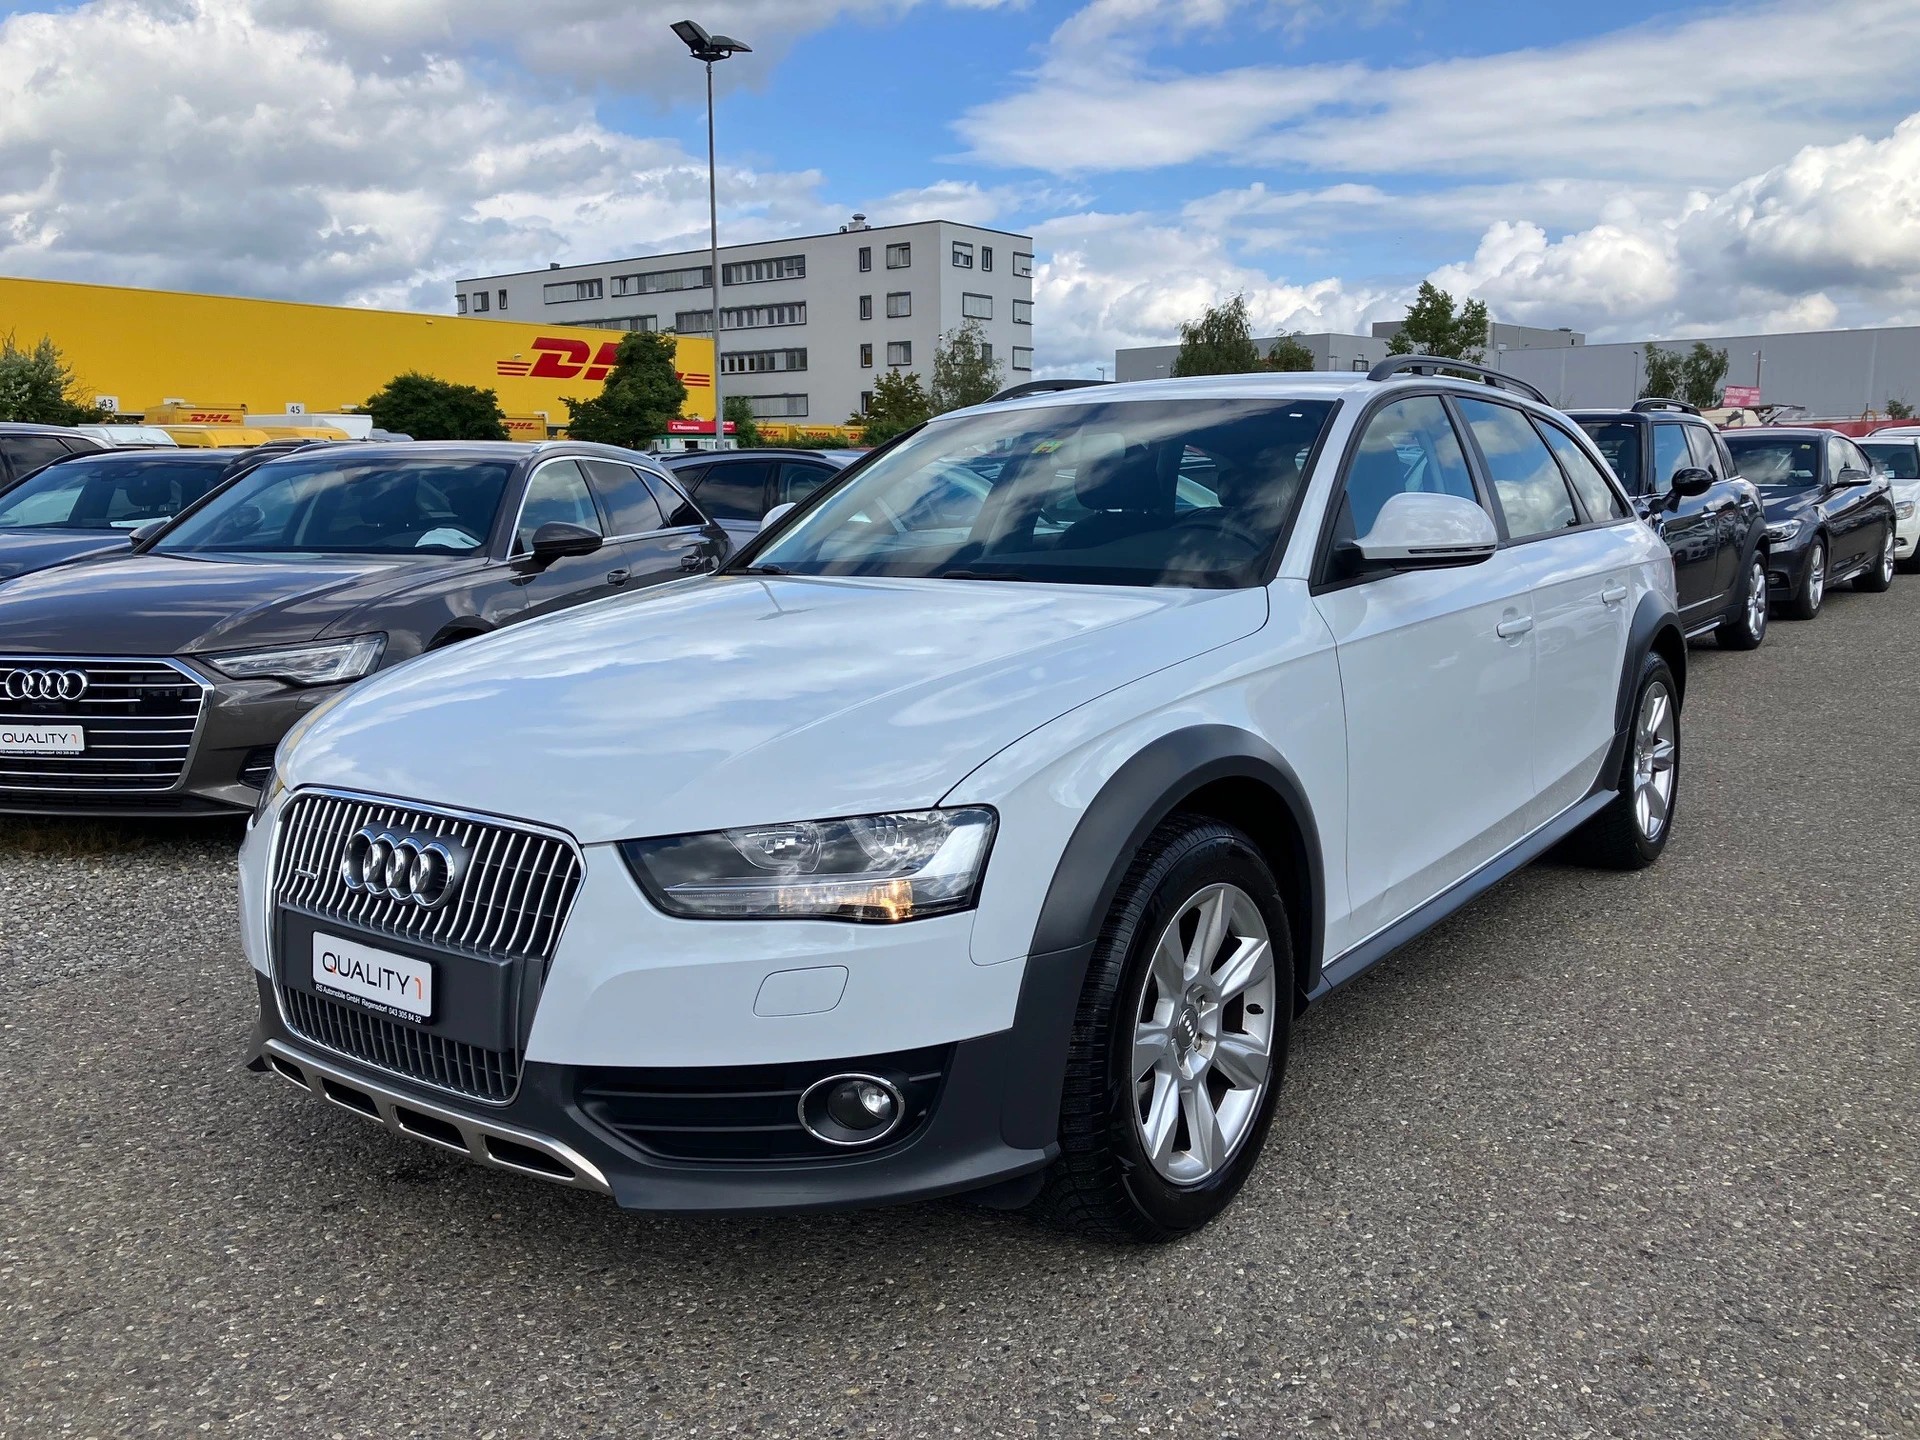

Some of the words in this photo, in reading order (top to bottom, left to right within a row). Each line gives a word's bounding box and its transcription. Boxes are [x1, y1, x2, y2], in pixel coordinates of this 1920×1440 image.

[290, 405, 301, 414] 45
[190, 413, 233, 423] DHL
[316, 983, 323, 992] RS
[323, 986, 346, 1000] Automobile
[346, 993, 360, 1004] GmbH
[398, 1010, 407, 1019] 305
[414, 1015, 422, 1024] 32
